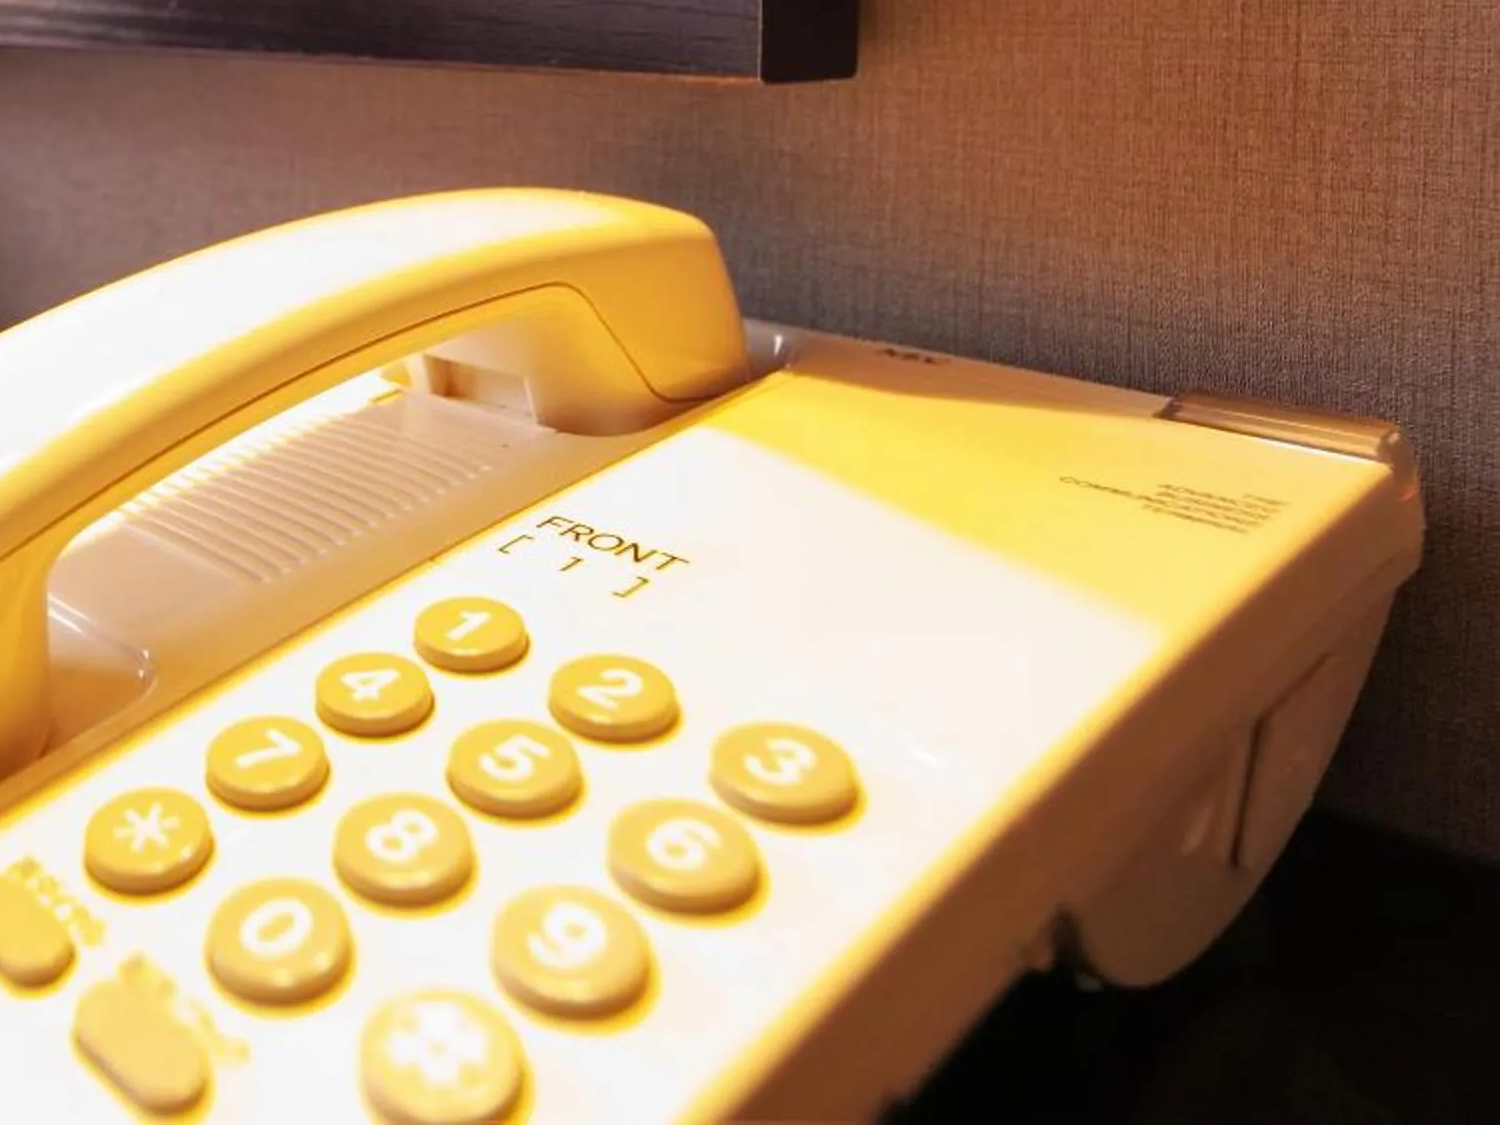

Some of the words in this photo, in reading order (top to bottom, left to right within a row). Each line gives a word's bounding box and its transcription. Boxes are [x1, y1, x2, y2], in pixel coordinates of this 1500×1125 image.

[536, 515, 690, 571] FRONT
[445, 610, 492, 640] 1
[340, 667, 401, 699] 4
[575, 668, 644, 709] 2
[234, 728, 301, 769] 7
[478, 734, 551, 781] 5
[743, 736, 818, 786] 3
[364, 808, 438, 862] 8
[646, 817, 721, 871] 6
[239, 897, 313, 958] 0
[527, 900, 608, 969] 9
